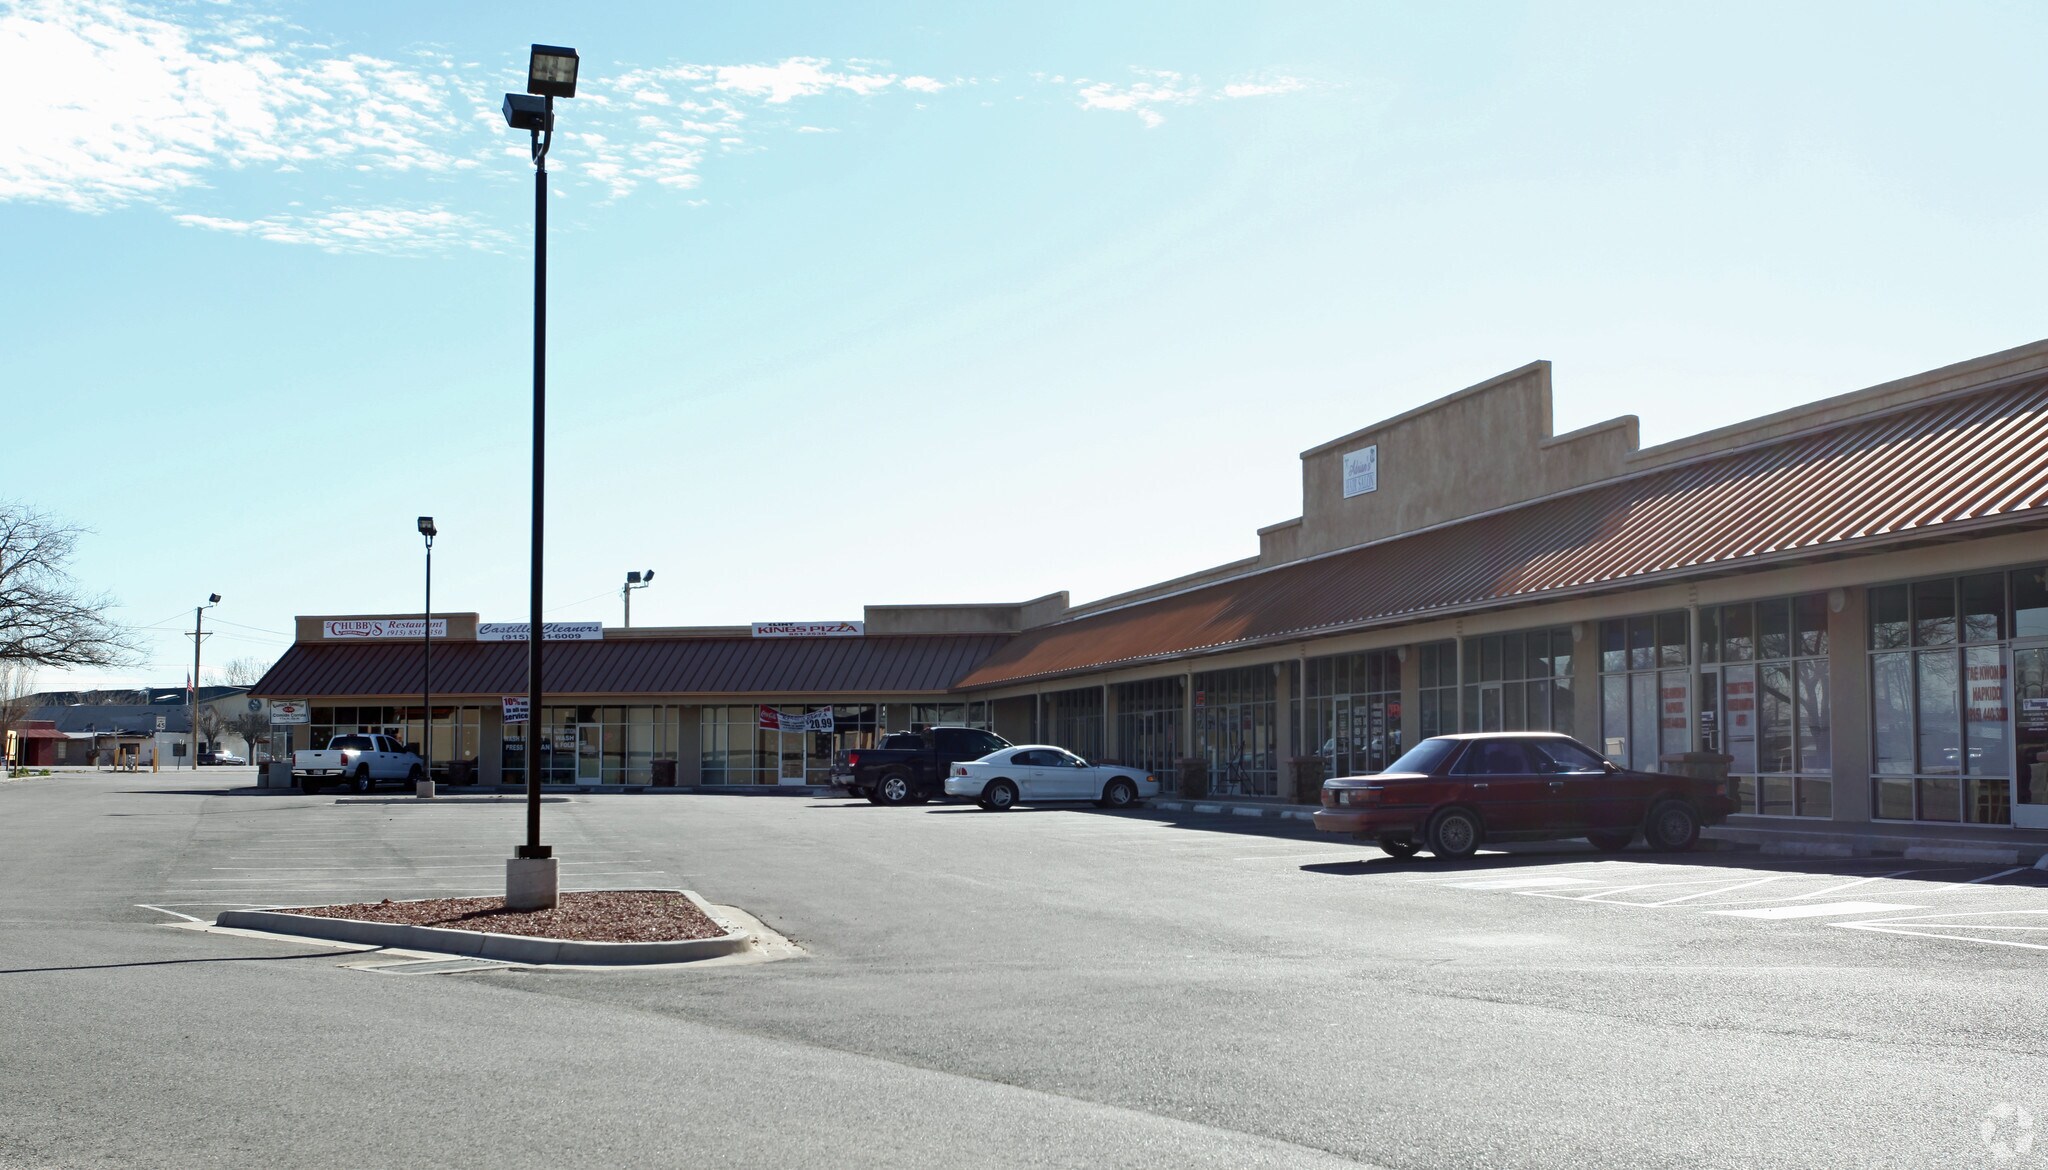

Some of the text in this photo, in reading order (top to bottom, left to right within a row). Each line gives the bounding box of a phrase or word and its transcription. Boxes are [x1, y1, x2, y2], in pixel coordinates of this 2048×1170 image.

[388, 620, 443, 628] Restaurnt
[542, 622, 600, 634] Cleaners
[757, 624, 858, 634] KINGS PIZZA
[504, 697, 520, 706] 10%
